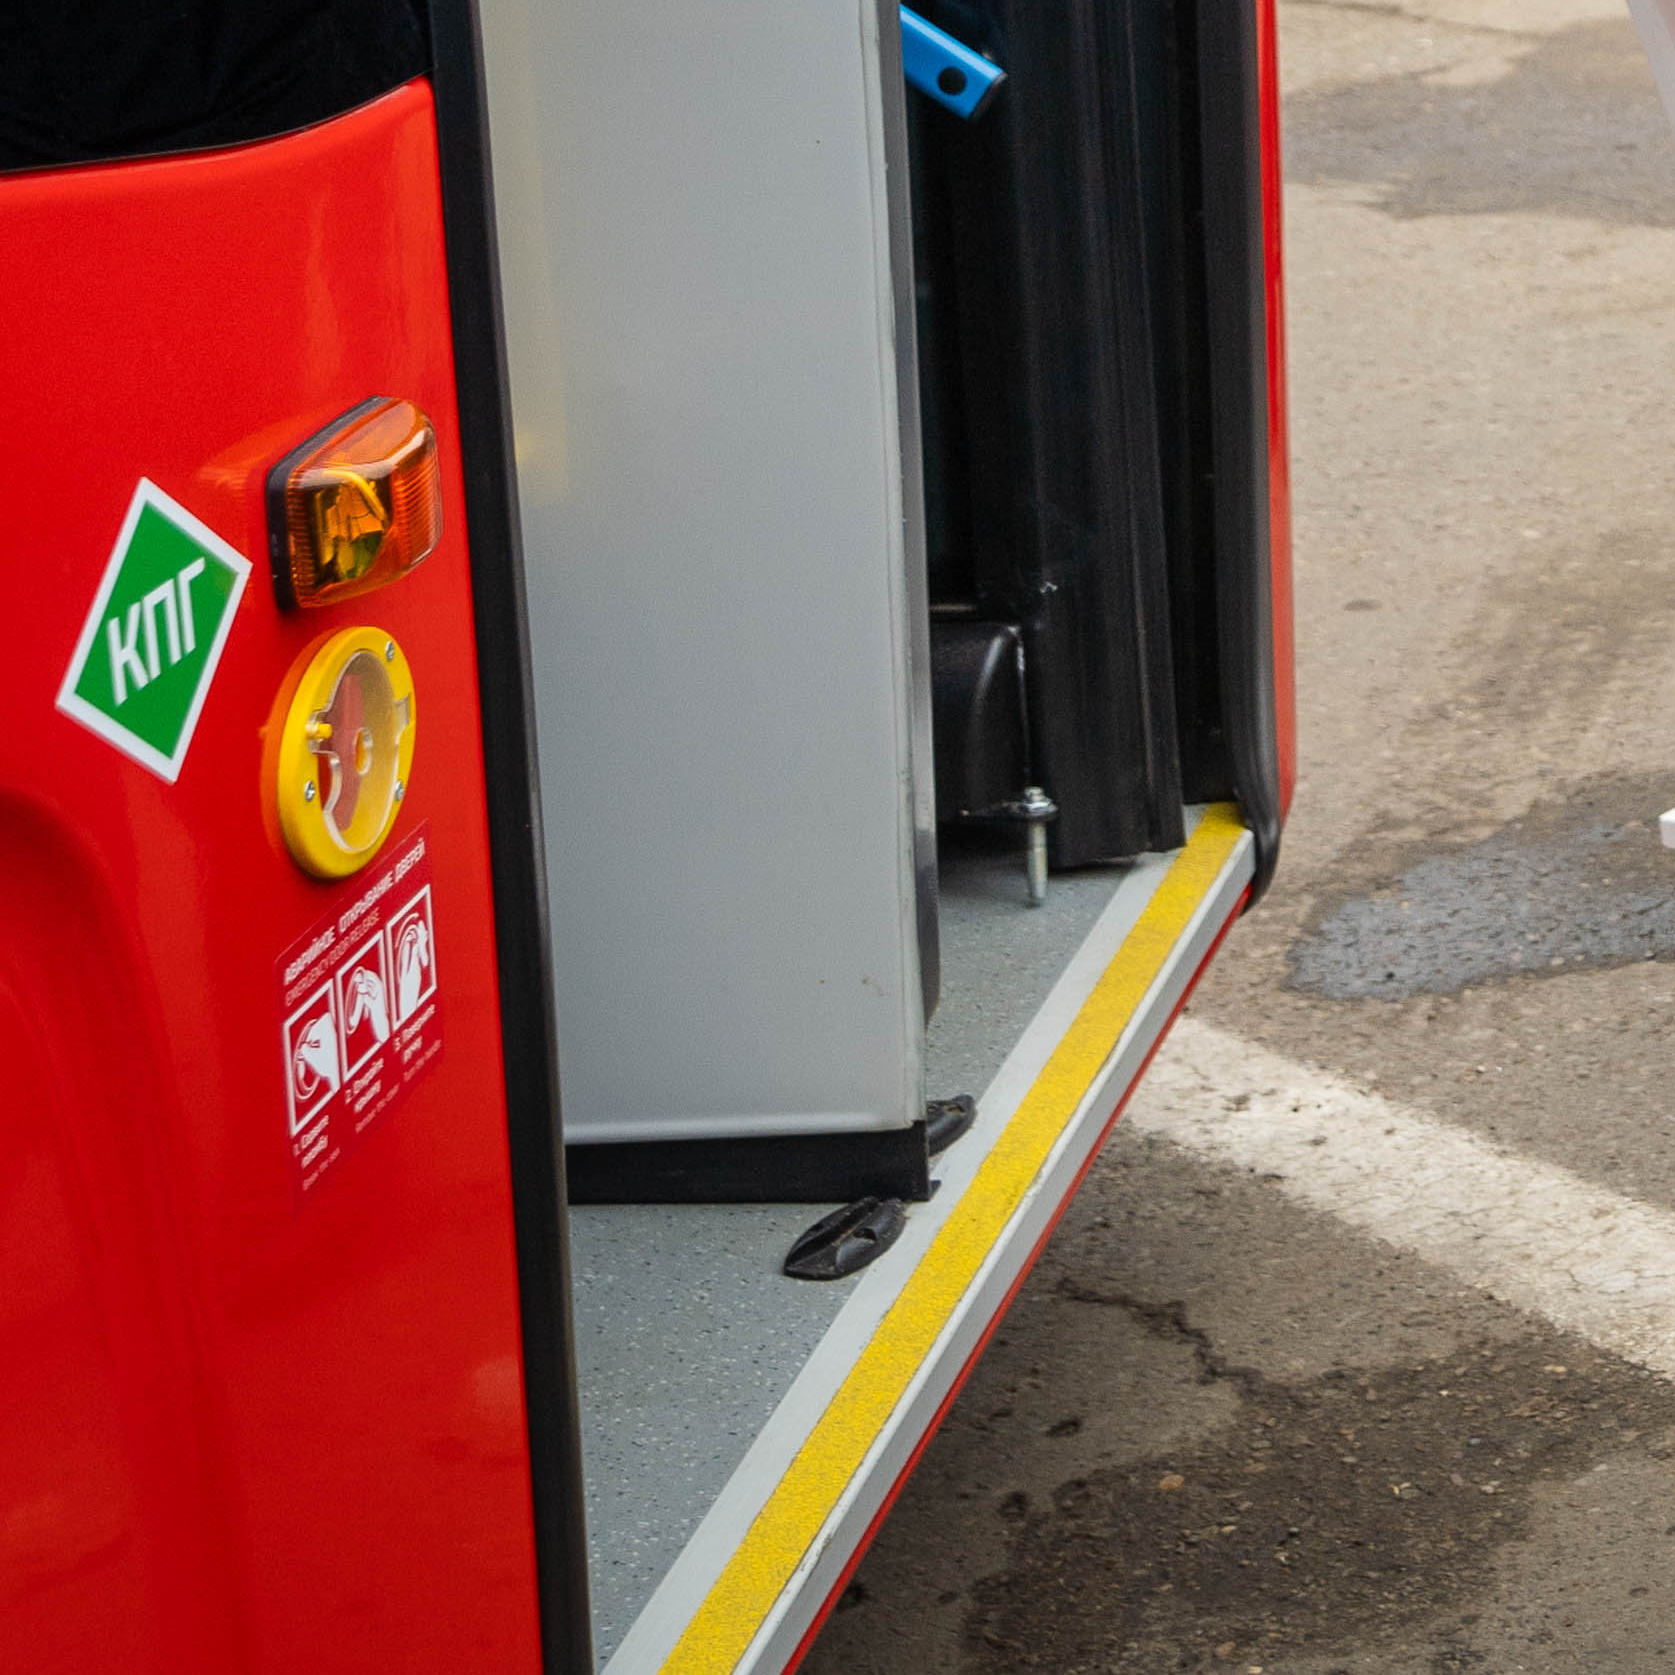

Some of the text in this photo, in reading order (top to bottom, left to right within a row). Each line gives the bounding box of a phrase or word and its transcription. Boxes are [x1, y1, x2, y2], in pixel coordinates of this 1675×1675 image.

[107, 557, 205, 707] КПГ
[284, 837, 426, 985] АВАРИЙНОЕ ОТКРЫВАНИЕ ДВЕРЕЙ
[285, 907, 380, 1006] EMERGENCY DOOR RELEASE
